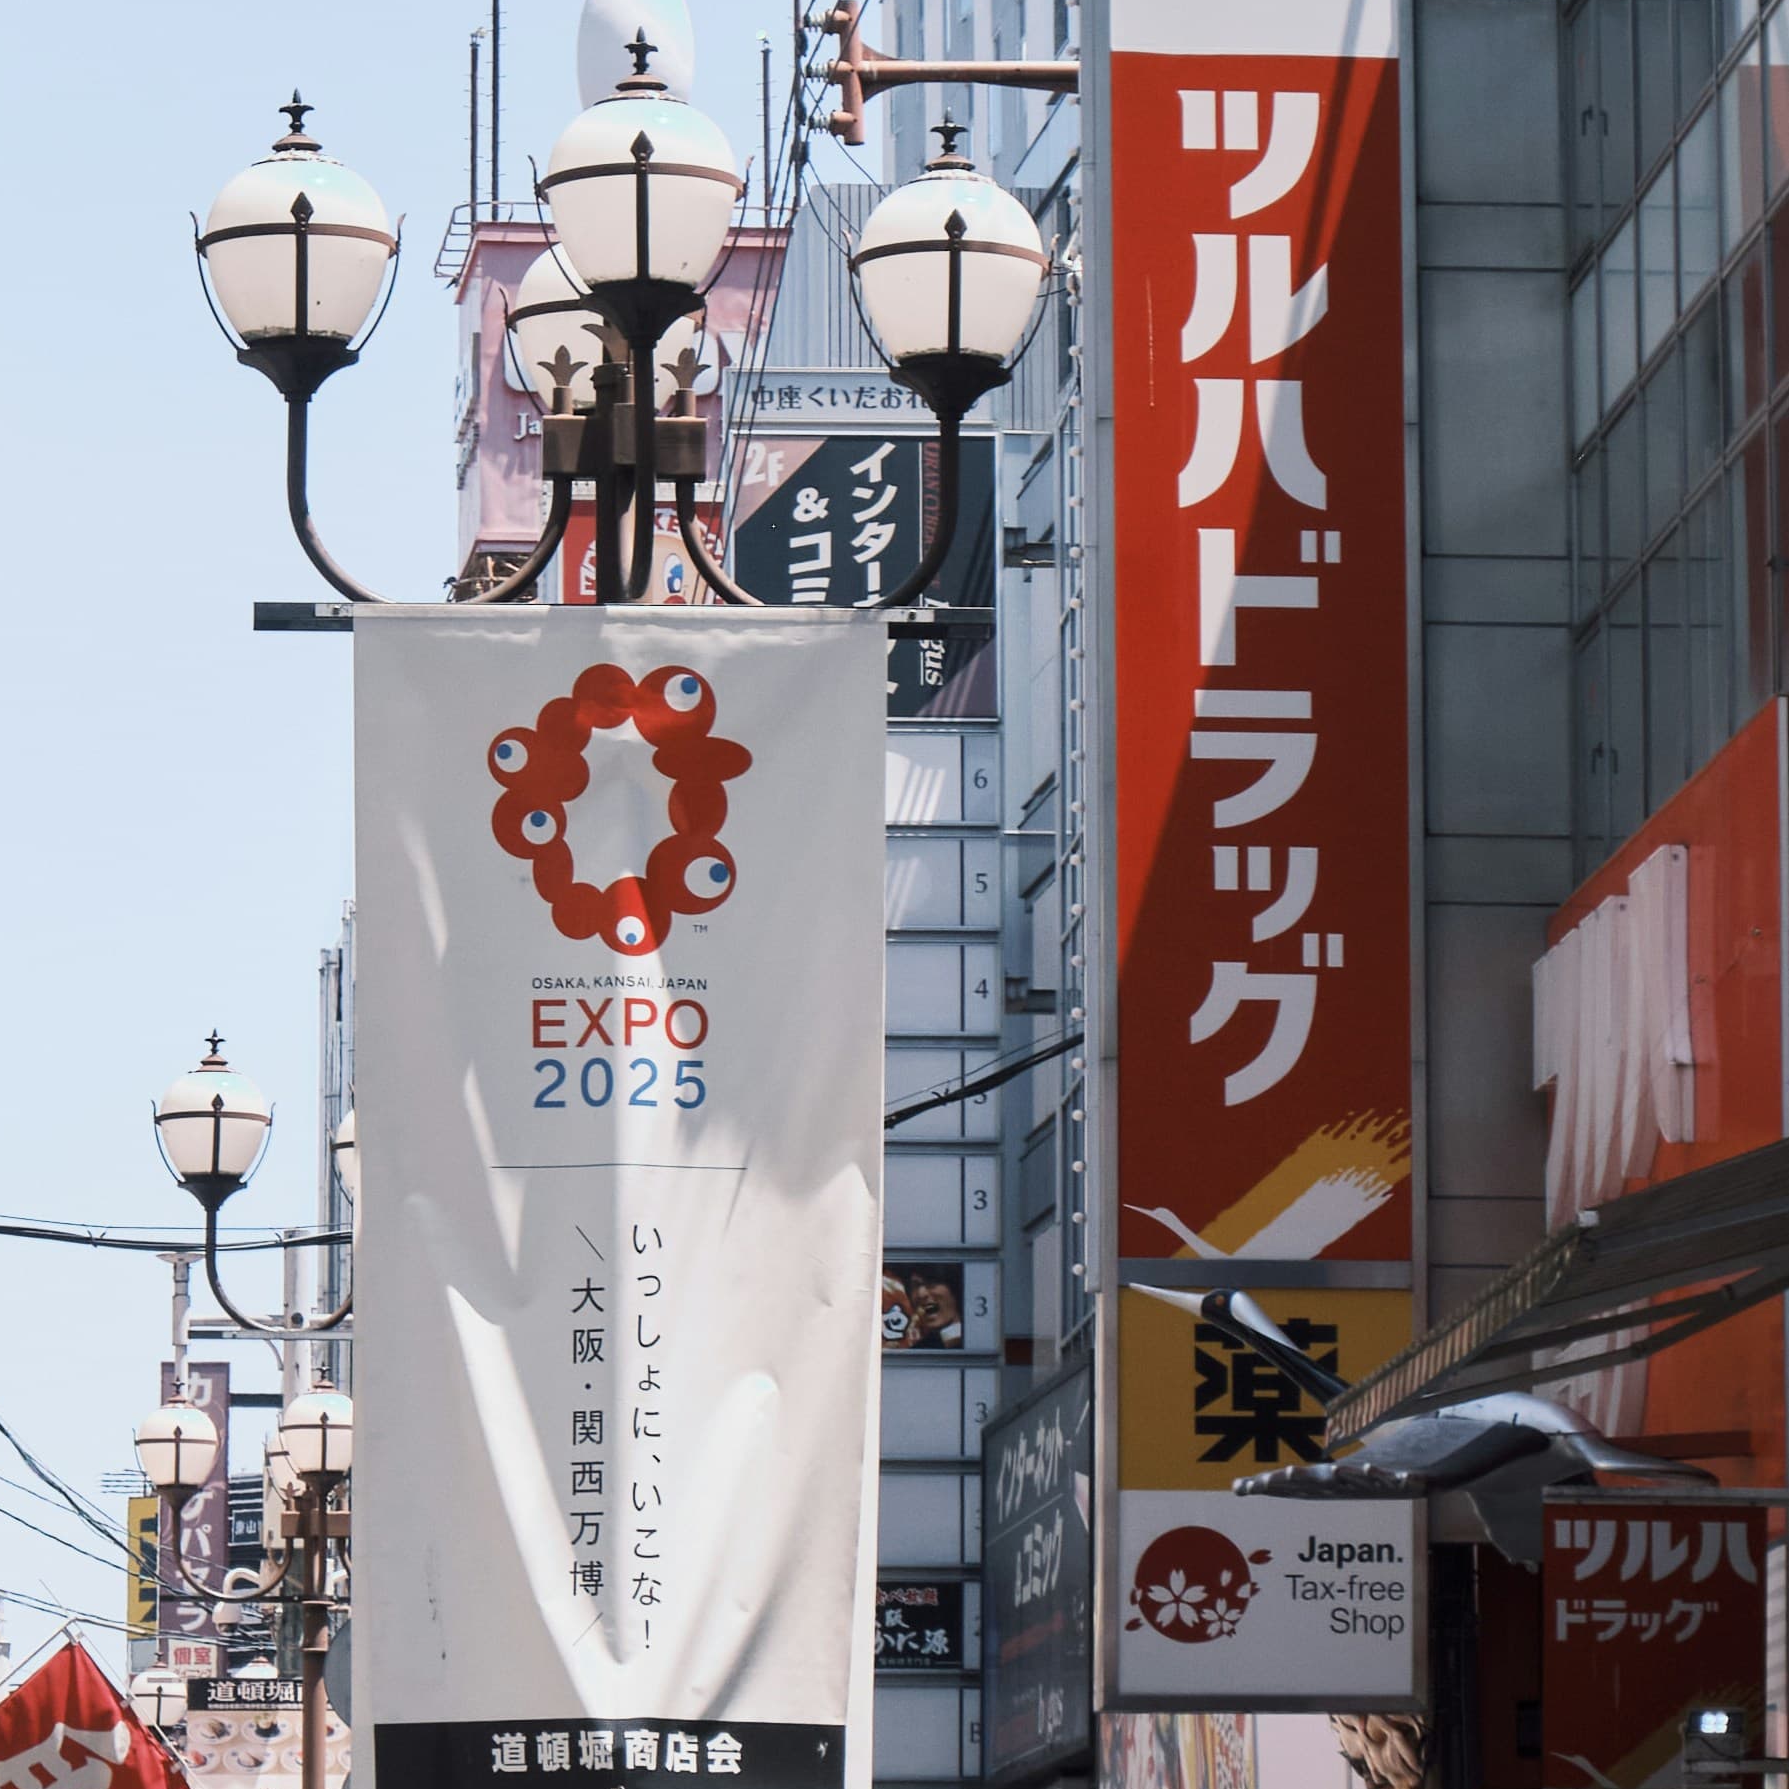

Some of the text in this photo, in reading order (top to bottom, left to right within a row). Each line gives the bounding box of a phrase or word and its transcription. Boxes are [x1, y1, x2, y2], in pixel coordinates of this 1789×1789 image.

[743, 441, 785, 487] 2F
[1178, 89, 1345, 1107] ツルハドラッグ
[973, 769, 989, 791] 6
[974, 871, 989, 895] 5
[531, 974, 709, 992] OSAKA, KANSAI, JAPAN
[974, 979, 990, 999] 4
[530, 998, 710, 1049] EXPO
[532, 1059, 708, 1110] 2025
[973, 1188, 988, 1211] 3
[973, 1295, 988, 1319] 3
[974, 1401, 988, 1424] 3
[567, 1276, 606, 1598] 大阪・関西万博
[1298, 1536, 1405, 1571] Japan.
[1553, 1519, 1758, 1585] ツルハ
[1285, 1573, 1405, 1603] Tax-free
[1329, 1608, 1405, 1641] Shop
[1555, 1597, 1721, 1644] ドラッグ
[491, 1729, 745, 1776] 道頓堀商店会
